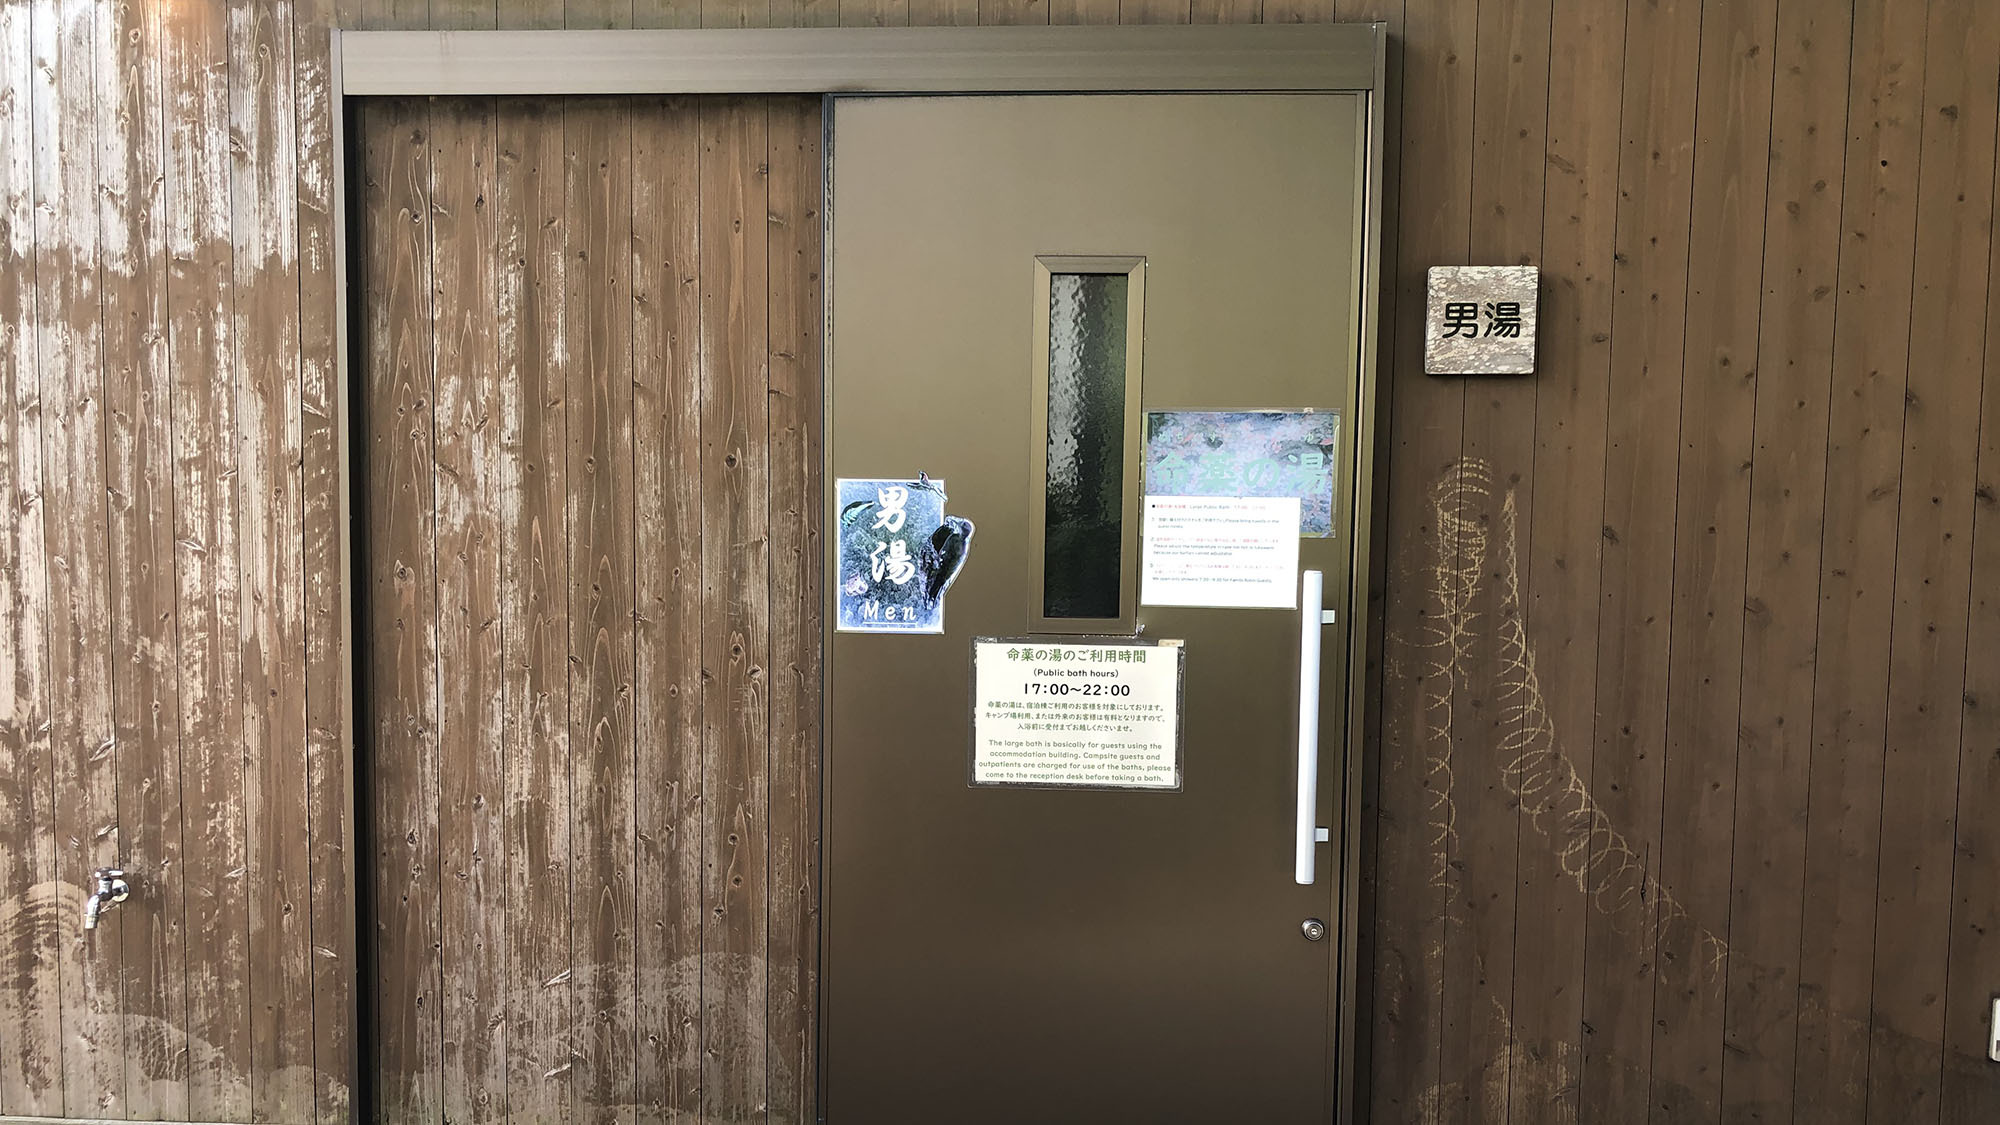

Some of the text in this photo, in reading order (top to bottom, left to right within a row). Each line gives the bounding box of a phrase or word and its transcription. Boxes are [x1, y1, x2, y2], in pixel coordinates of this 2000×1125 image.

[1442, 302, 1521, 339] 男湯
[1152, 451, 1329, 495] 命薬の湯
[870, 485, 916, 585] 男湯
[863, 599, 917, 621] Men
[1006, 647, 1147, 664] 命薬の湯のご利用時間
[1033, 668, 1119, 678] (Public bath hours)
[1005, 740, 1023, 748] large
[1101, 742, 1125, 750] guests
[1083, 752, 1118, 760] Campsite
[1037, 762, 1067, 770] charged
[1112, 774, 1135, 782] taking
